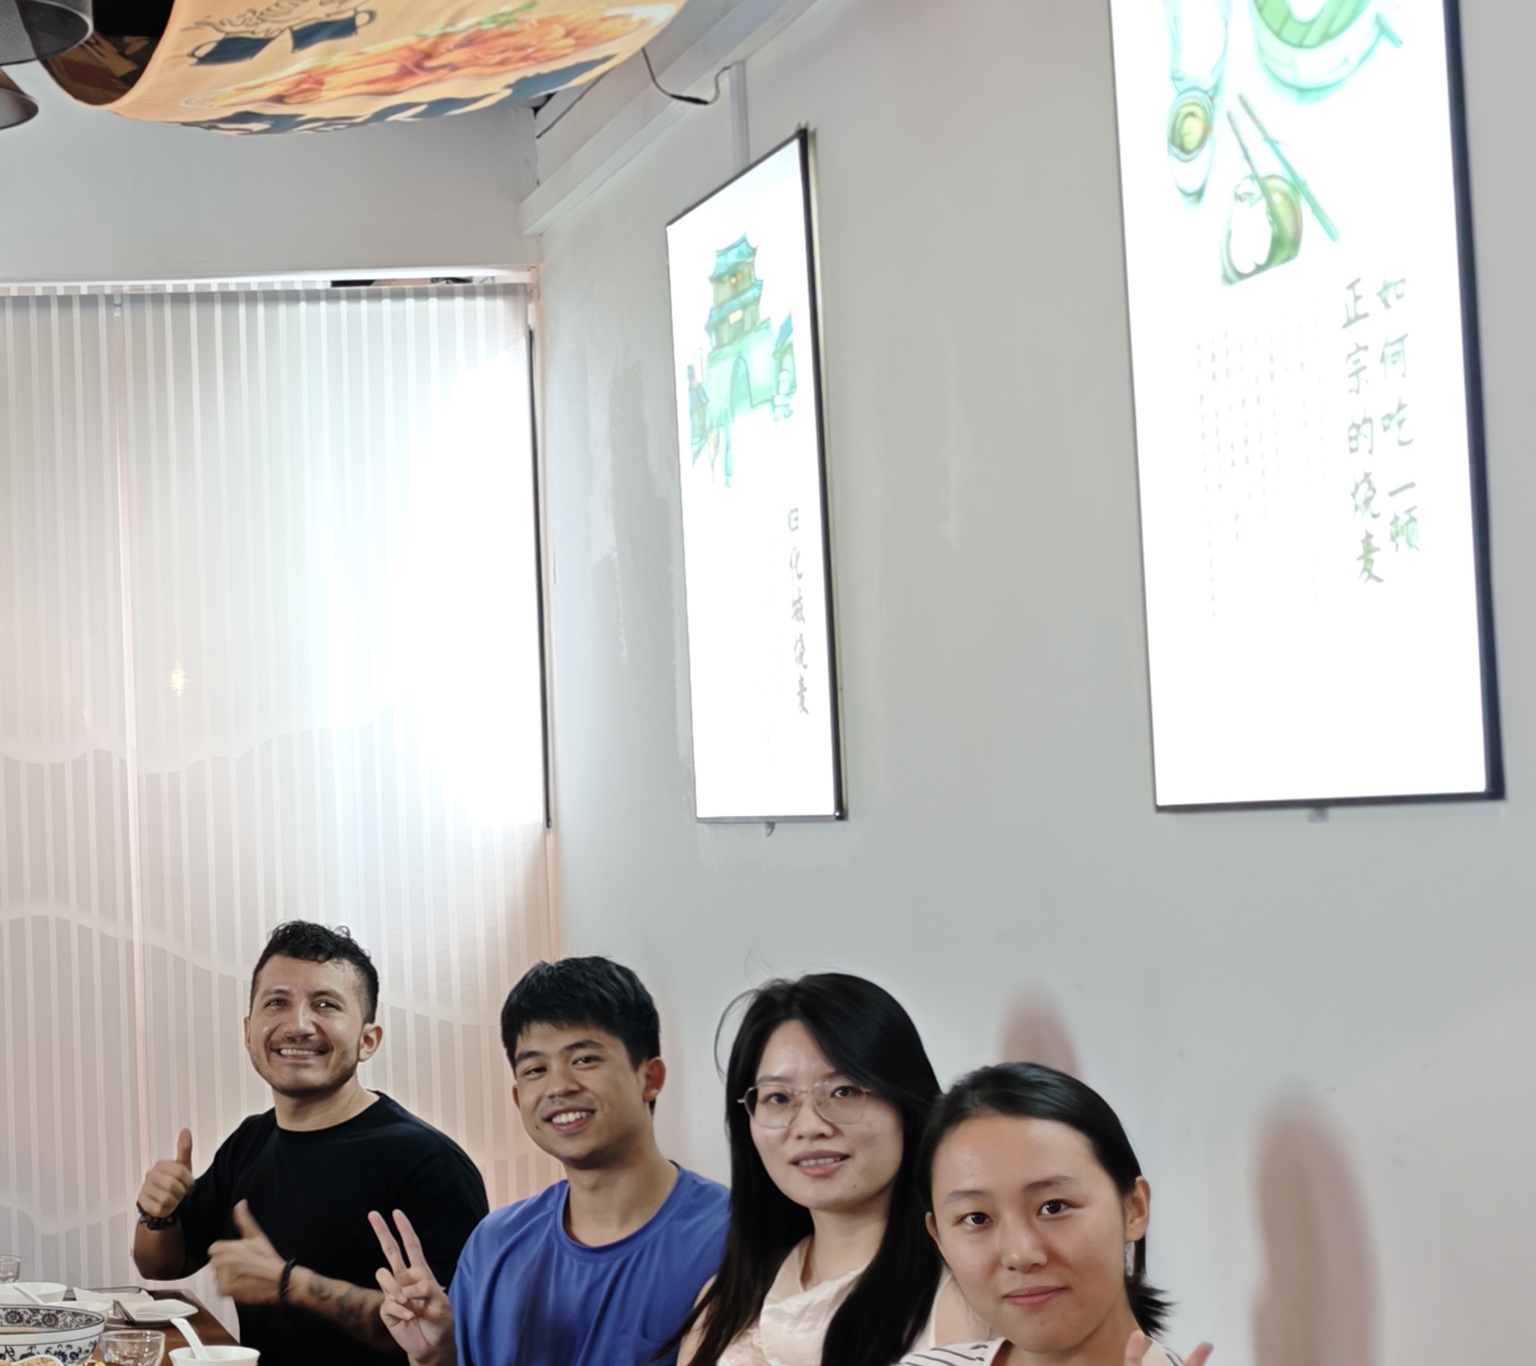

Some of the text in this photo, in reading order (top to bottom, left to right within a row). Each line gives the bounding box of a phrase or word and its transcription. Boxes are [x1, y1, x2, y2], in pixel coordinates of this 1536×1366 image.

[1340, 277, 1386, 585] 正宗的烧麦
[1376, 270, 1421, 554] 如何吃一顿
